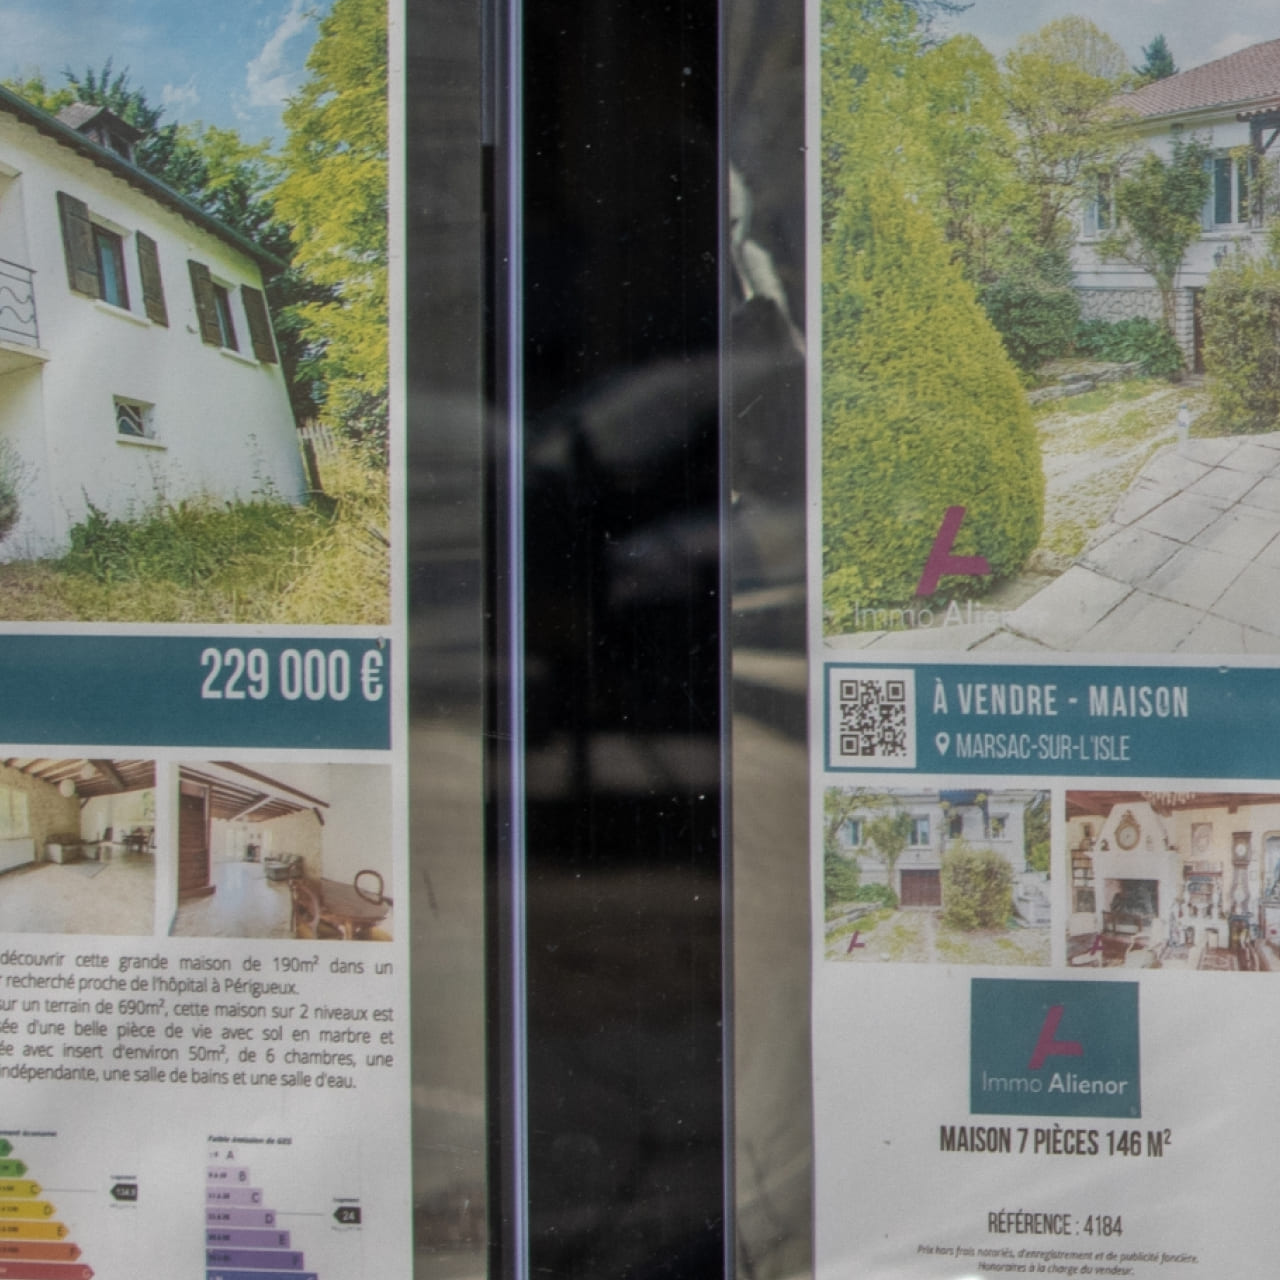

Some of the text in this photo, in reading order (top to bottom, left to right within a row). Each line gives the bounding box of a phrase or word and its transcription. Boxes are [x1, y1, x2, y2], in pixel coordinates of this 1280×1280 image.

[200, 647, 385, 702] 229 000 €
[933, 676, 949, 715] À
[956, 683, 1059, 716] VENDRE
[1088, 684, 1189, 718] MAISON
[955, 732, 1131, 761] MARSAC-SUR-L'ISLE
[0, 949, 66, 968] découvrir
[74, 952, 111, 969] cette
[117, 953, 169, 974] grande
[178, 957, 232, 972] maison
[241, 954, 262, 973] de
[328, 956, 366, 975] dans
[374, 962, 394, 976] un
[982, 1070, 1129, 1096] Immo Alienor
[939, 1124, 1012, 1154] MAISON
[1016, 1127, 1029, 1154] 7
[1033, 1123, 1100, 1156] PIÈCES
[1105, 1129, 1142, 1157] 146
